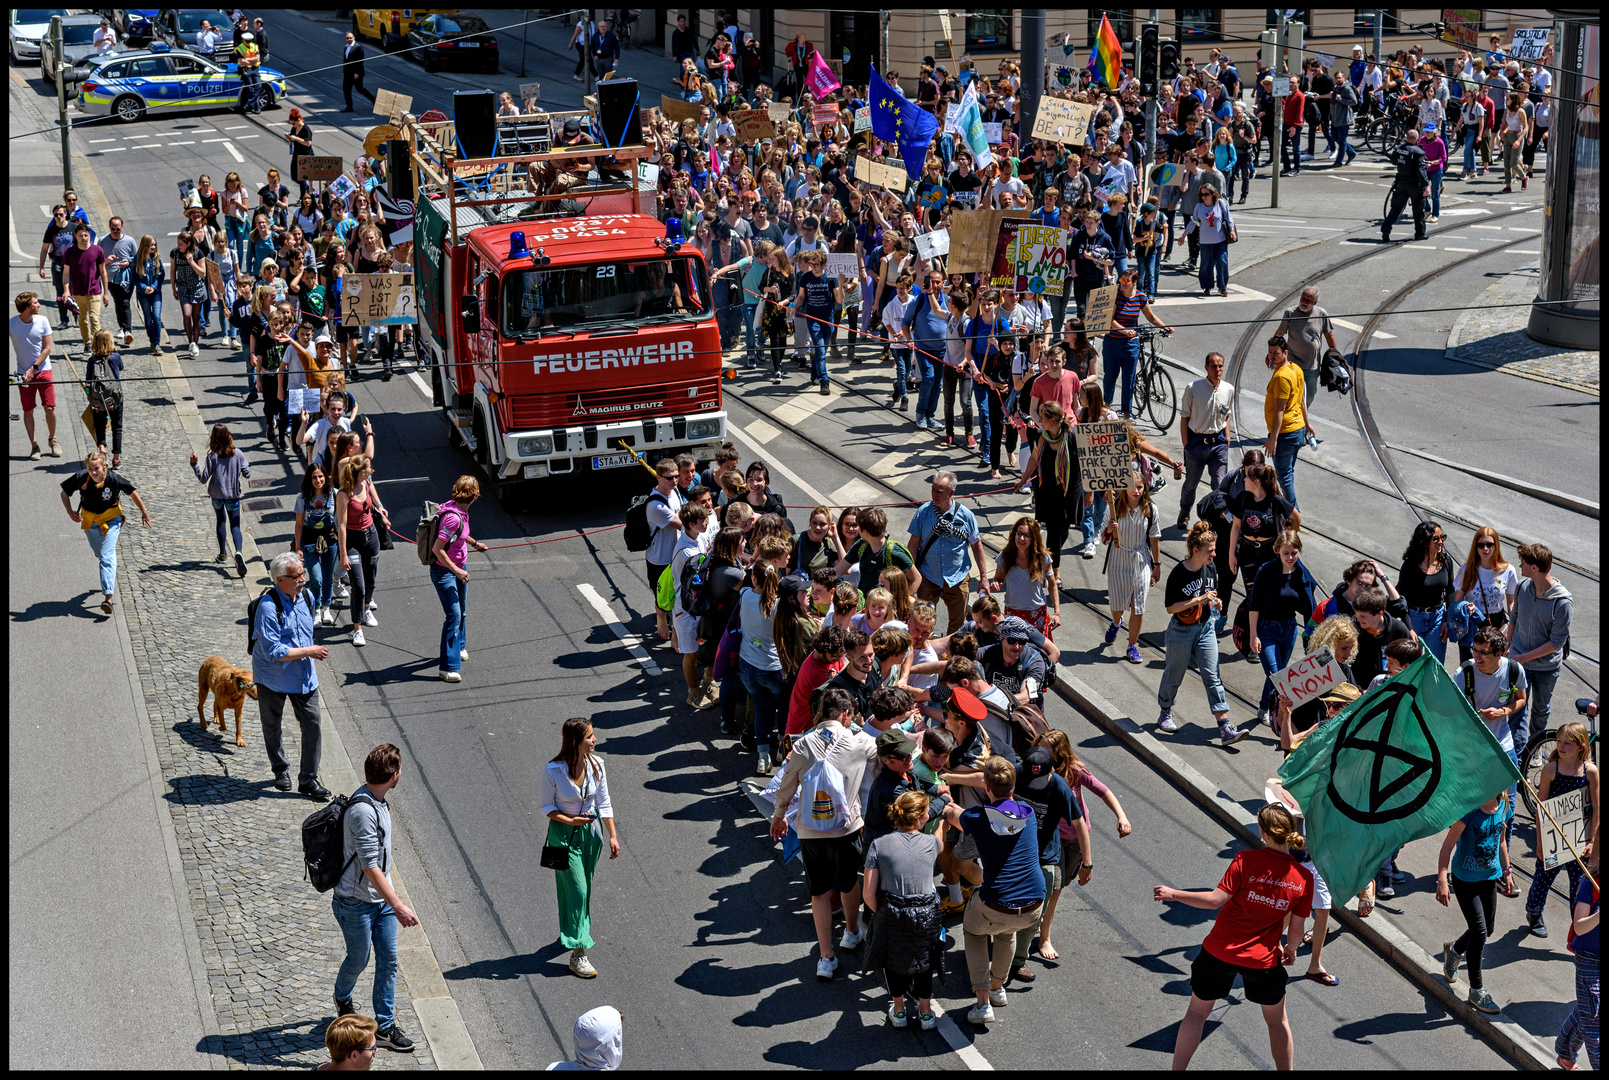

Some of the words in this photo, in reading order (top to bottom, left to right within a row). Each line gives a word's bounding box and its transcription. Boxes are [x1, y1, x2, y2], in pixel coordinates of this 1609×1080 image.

[1510, 45, 1543, 59] KLIMATET
[188, 85, 224, 94] POLIZEI
[1046, 99, 1065, 108] Seid
[1045, 111, 1086, 122] eigentlich
[1035, 119, 1054, 135] BE
[1018, 226, 1062, 246] THERE
[1019, 243, 1034, 261] IS
[1040, 246, 1065, 268] NO
[596, 265, 616, 279] 23
[825, 264, 858, 276] SCIENCE
[1016, 260, 1066, 280] PLANET
[368, 278, 392, 290] WAS
[402, 295, 411, 315] ?
[1086, 321, 1107, 331] ZEIT
[533, 340, 694, 375] FEUERWEHR
[589, 404, 631, 414] MAGIRUS
[633, 401, 664, 410] DEUTZ
[700, 401, 716, 409] 170
[1092, 423, 1128, 434] GETTING
[1091, 434, 1114, 445] HOT
[1078, 447, 1087, 457] IN
[598, 456, 614, 468] STA
[618, 454, 629, 464] XY
[1080, 457, 1107, 468] TAKE
[1110, 455, 1130, 467] OFF
[1082, 468, 1101, 480] ALL
[1102, 468, 1131, 478] YOUR
[1089, 478, 1128, 490] COALS
[1288, 654, 1317, 683] ACT
[1292, 664, 1333, 700] NOW
[1247, 890, 1276, 905] Reece
